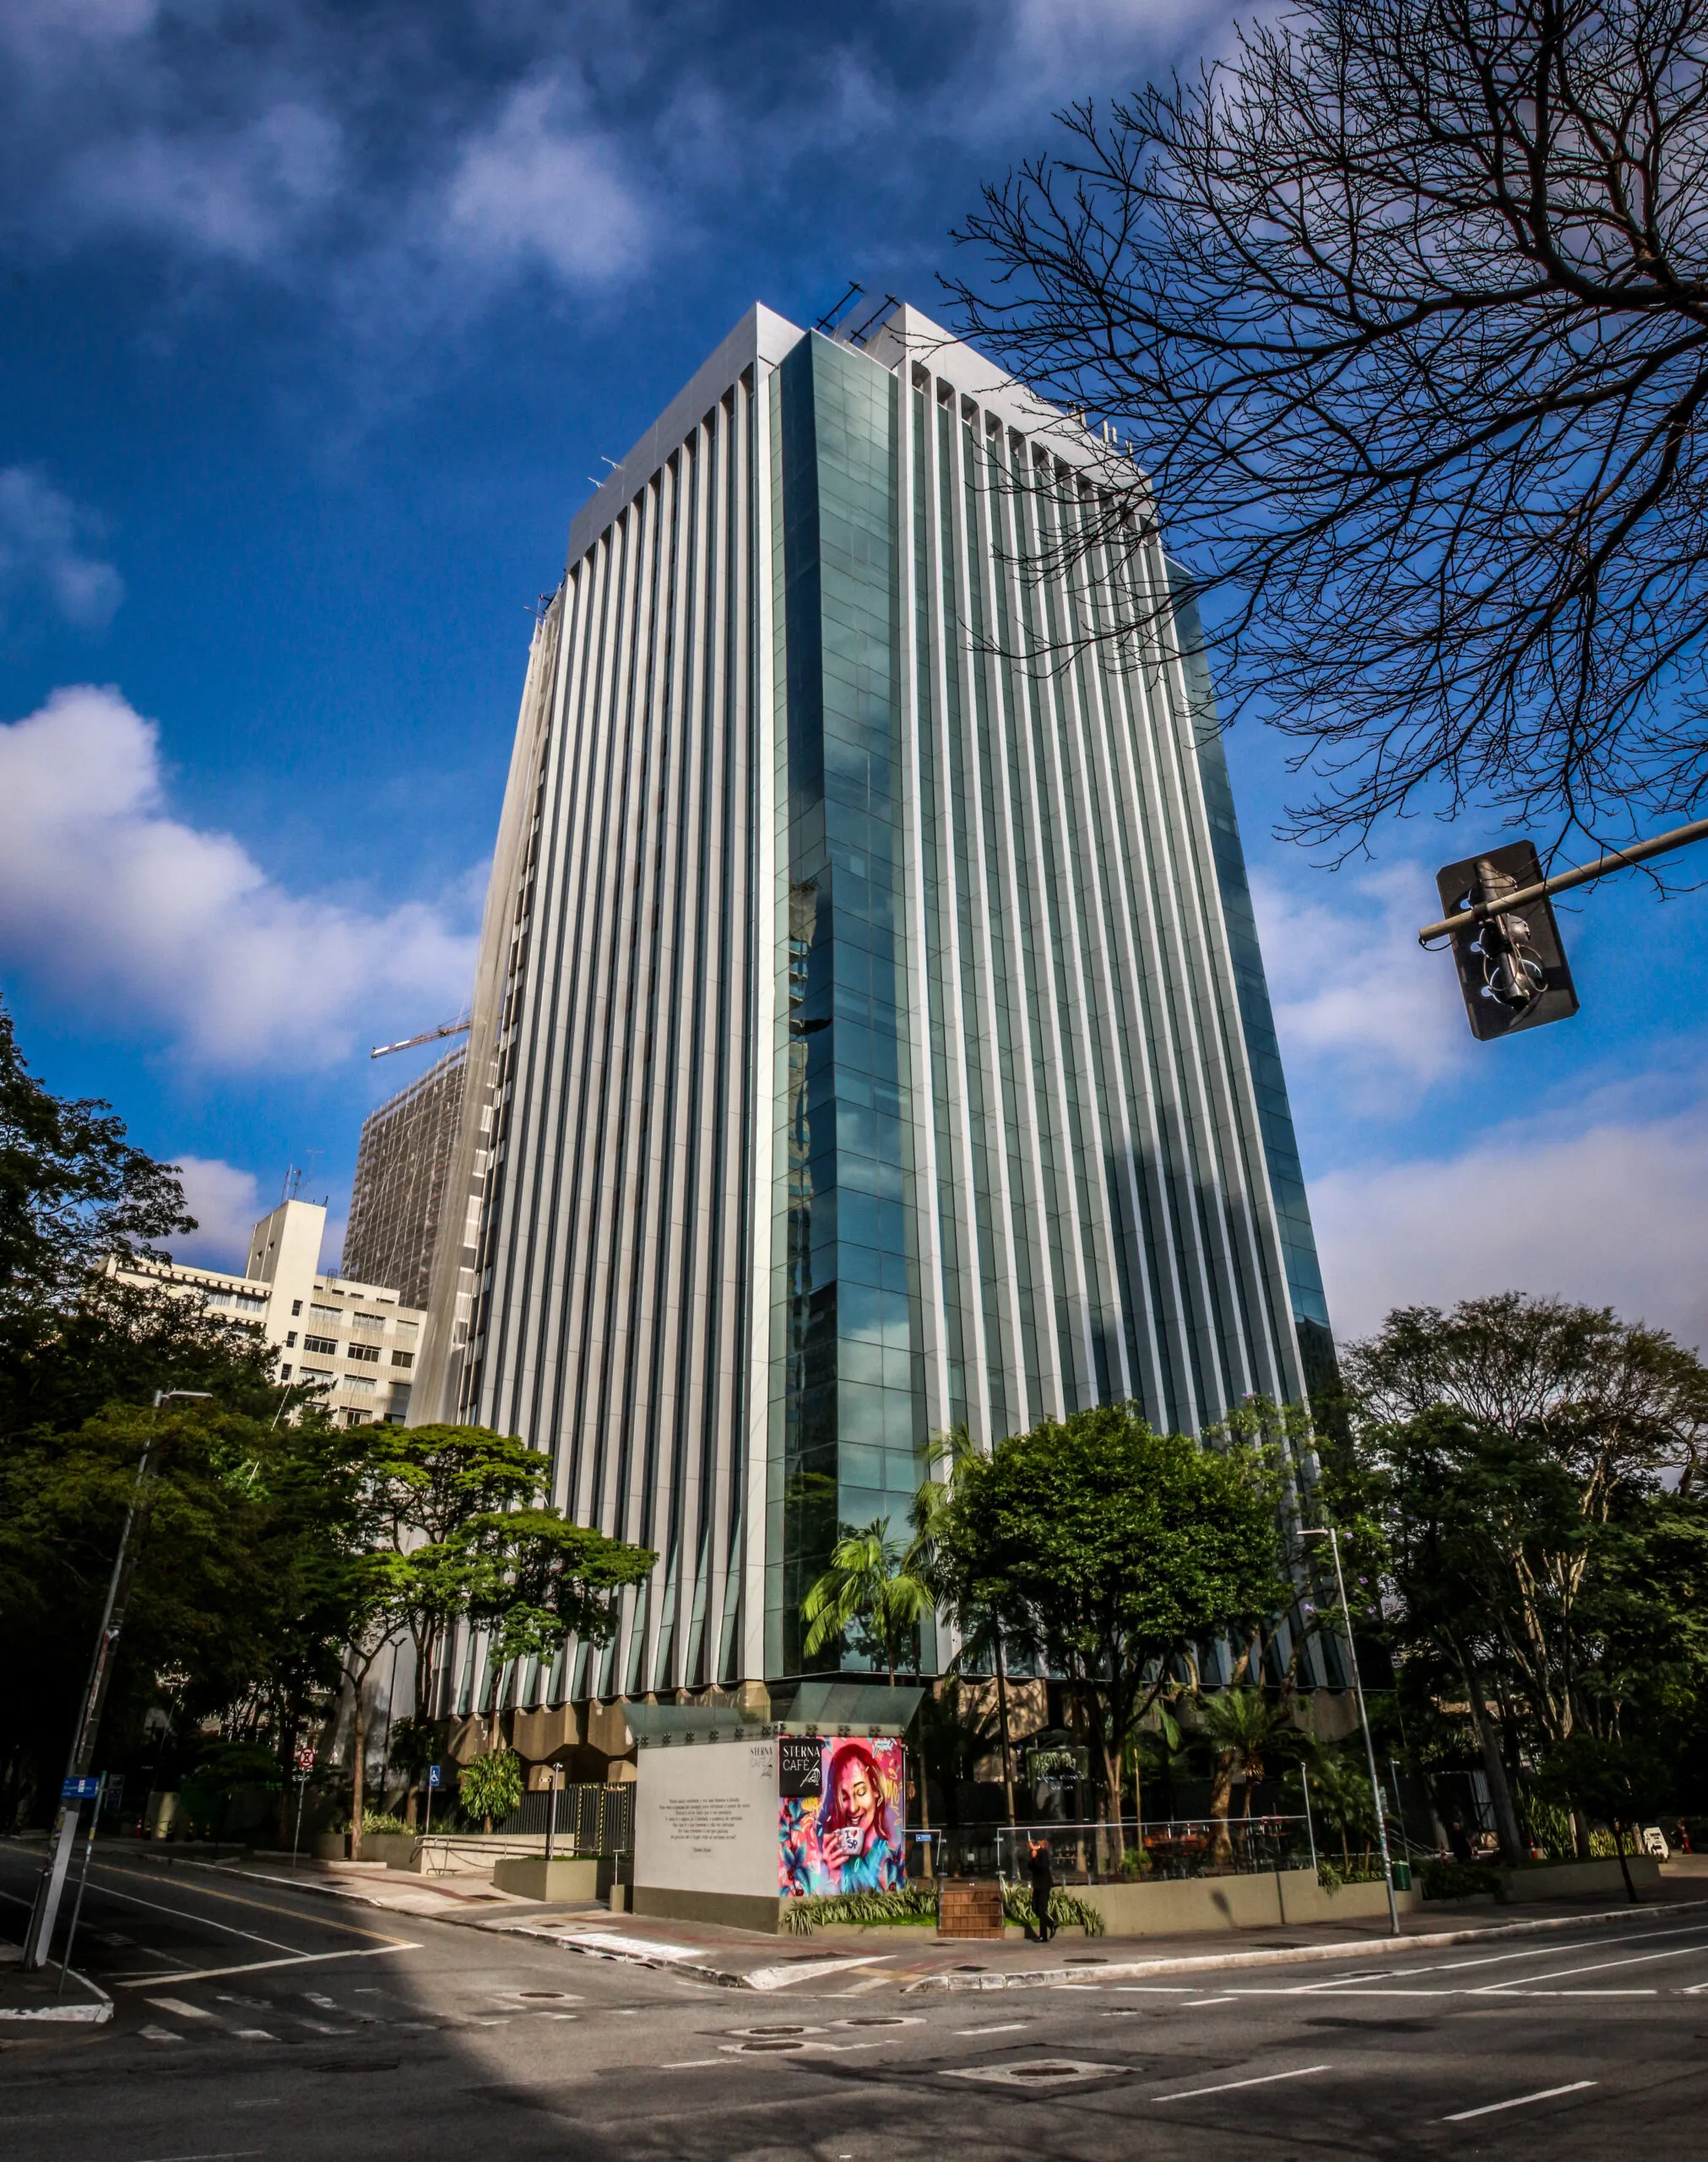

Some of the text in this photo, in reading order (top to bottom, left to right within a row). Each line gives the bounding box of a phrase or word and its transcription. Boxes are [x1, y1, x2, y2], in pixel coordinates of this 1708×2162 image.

[783, 1746, 821, 1757] STERNA
[783, 1757, 810, 1771] CAFÉ
[847, 1839, 858, 1849] SP
